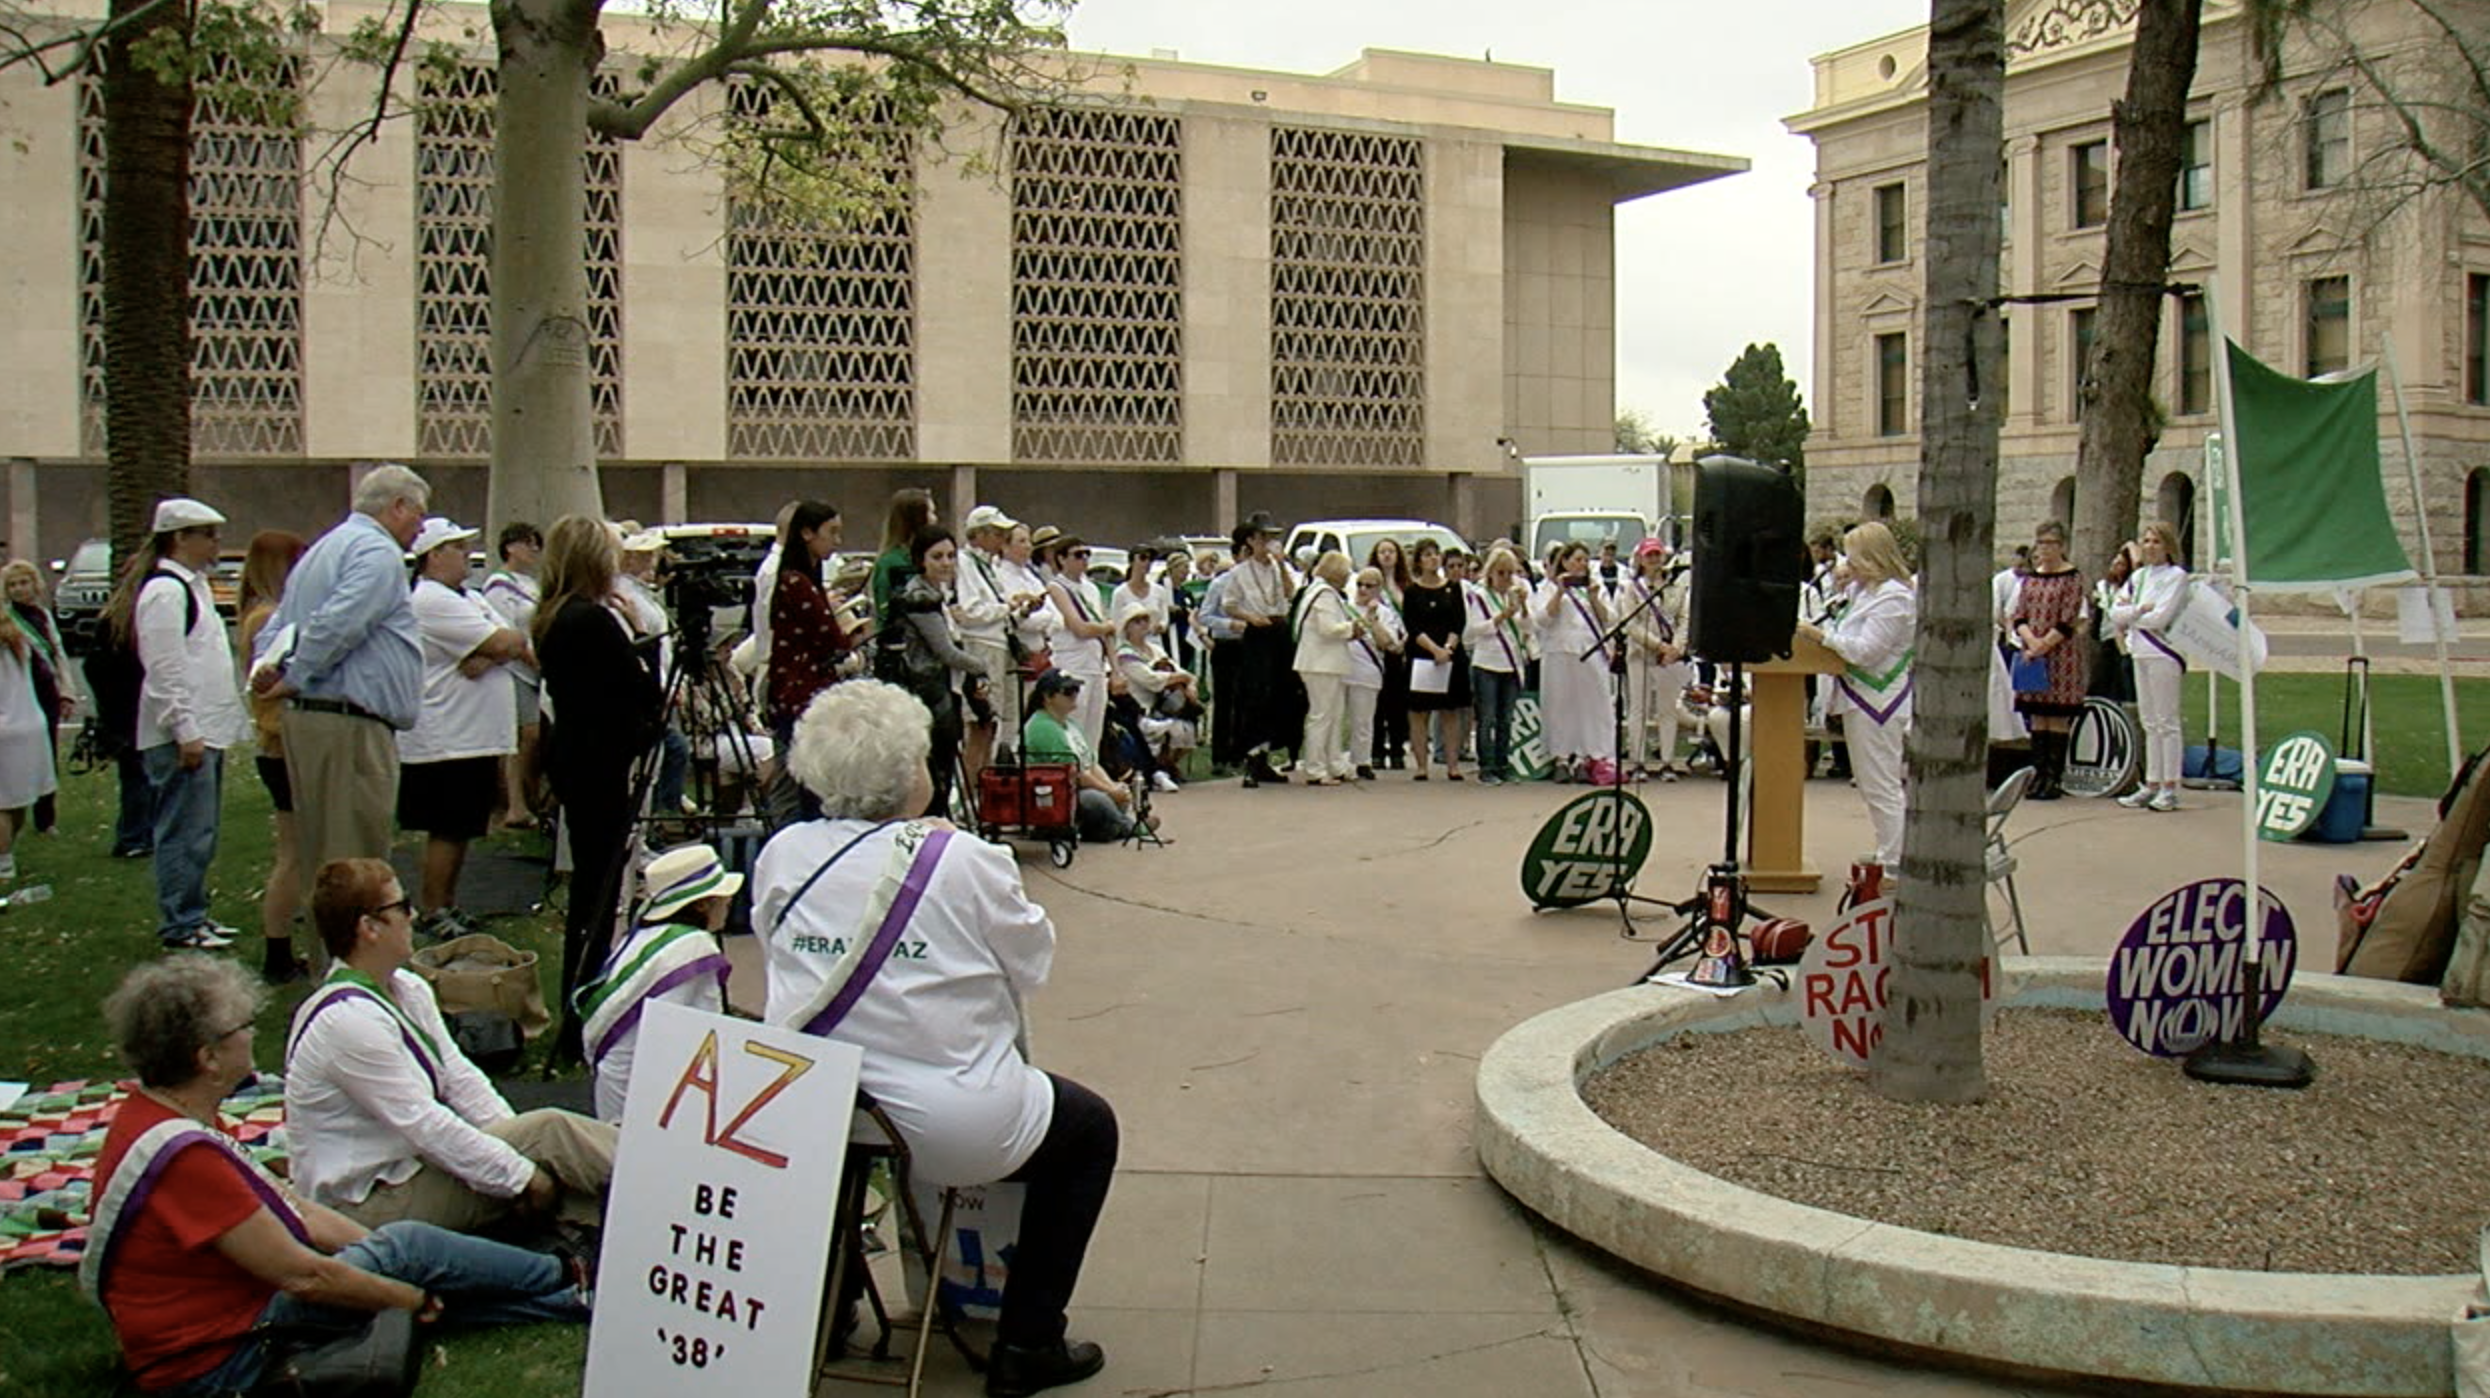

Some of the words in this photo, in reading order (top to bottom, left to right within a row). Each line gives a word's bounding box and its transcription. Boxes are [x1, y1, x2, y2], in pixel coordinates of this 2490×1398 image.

[1508, 697, 1541, 748] RA
[1506, 737, 1555, 777] YE
[2265, 736, 2327, 791] ERA
[1551, 796, 1643, 858] ERA
[2255, 787, 2314, 832] YES
[1825, 907, 1895, 969] ST
[2147, 882, 2281, 946] ELECT
[658, 1029, 815, 1169] AZ
[694, 1183, 737, 1219] BE
[670, 1223, 744, 1272] THE
[648, 1264, 764, 1331] GREAT
